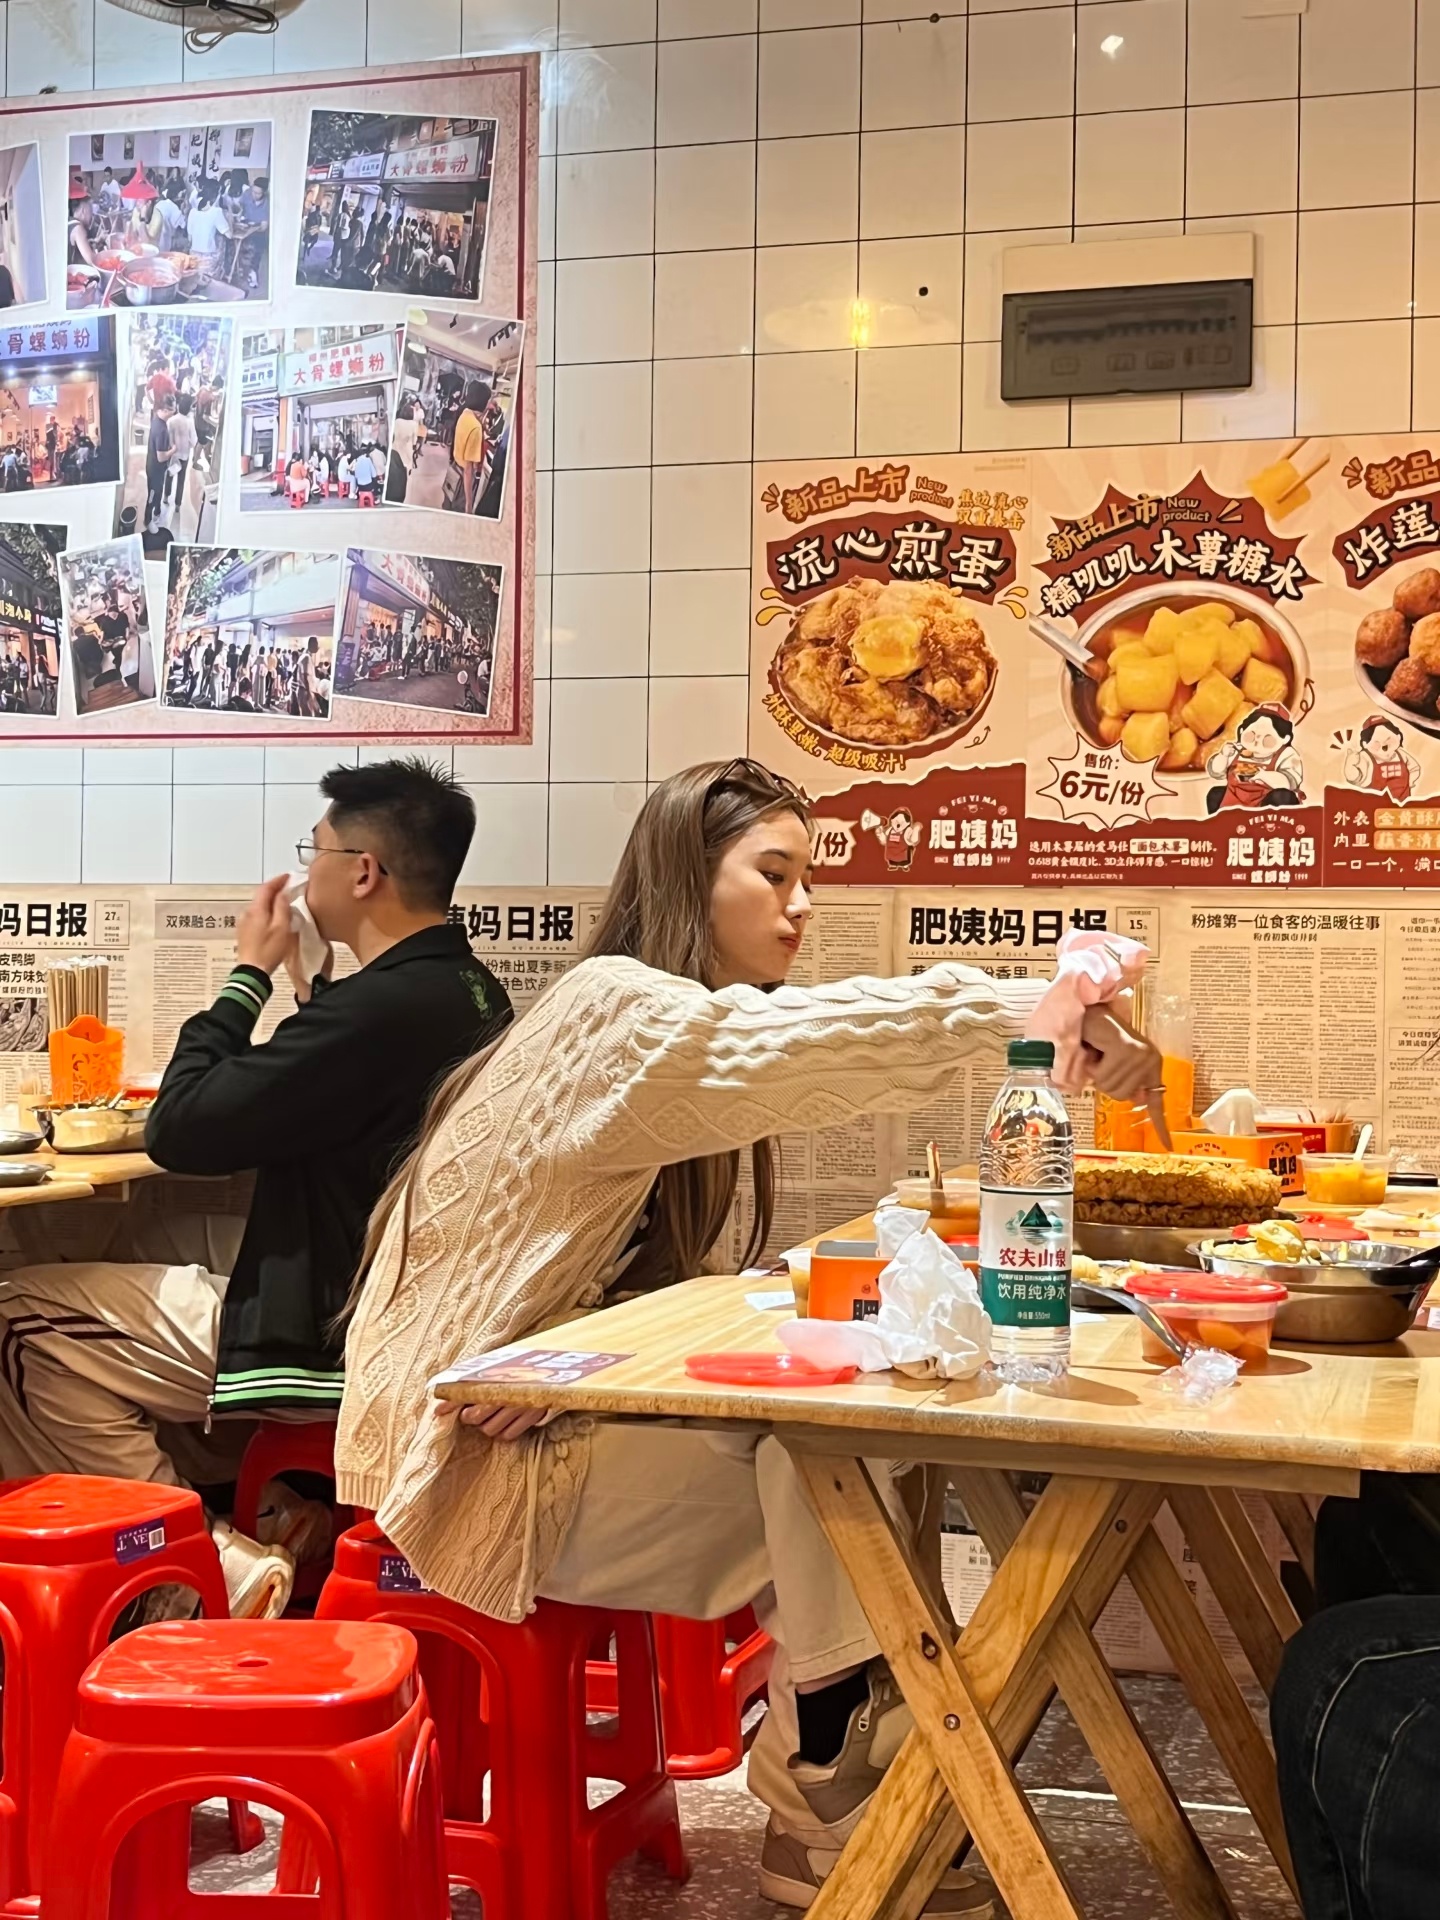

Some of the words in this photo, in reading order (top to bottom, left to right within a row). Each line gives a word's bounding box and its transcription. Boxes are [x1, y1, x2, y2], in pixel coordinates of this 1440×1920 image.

[0, 327, 90, 355] 骨螺蛳粉
[294, 351, 385, 386] 大骨螺蛳粉
[915, 476, 948, 493] New
[1366, 452, 1440, 499] 新品
[782, 464, 910, 523] 新品上市
[909, 490, 955, 509] product
[1167, 496, 1201, 509] New
[1047, 493, 1162, 560] 新品上市
[1162, 510, 1210, 524] product
[1343, 499, 1440, 579] 炸莲
[776, 522, 1008, 593] 流心煎蛋
[1042, 530, 1304, 616] 糯叽叽木薯糖水
[1059, 770, 1145, 806] 6元/份
[928, 818, 1018, 849] 肥姨妈
[1333, 811, 1370, 826] 外表
[1226, 837, 1315, 867] 肥姨妈
[1333, 833, 1370, 848] 内里
[909, 907, 1107, 947] 肥姨妈日报
[1192, 914, 1380, 931] 粉摊第一位食客的温暖往事
[999, 1247, 1066, 1268] 农夫山泉
[998, 1283, 1066, 1300] 饮用纯净水
